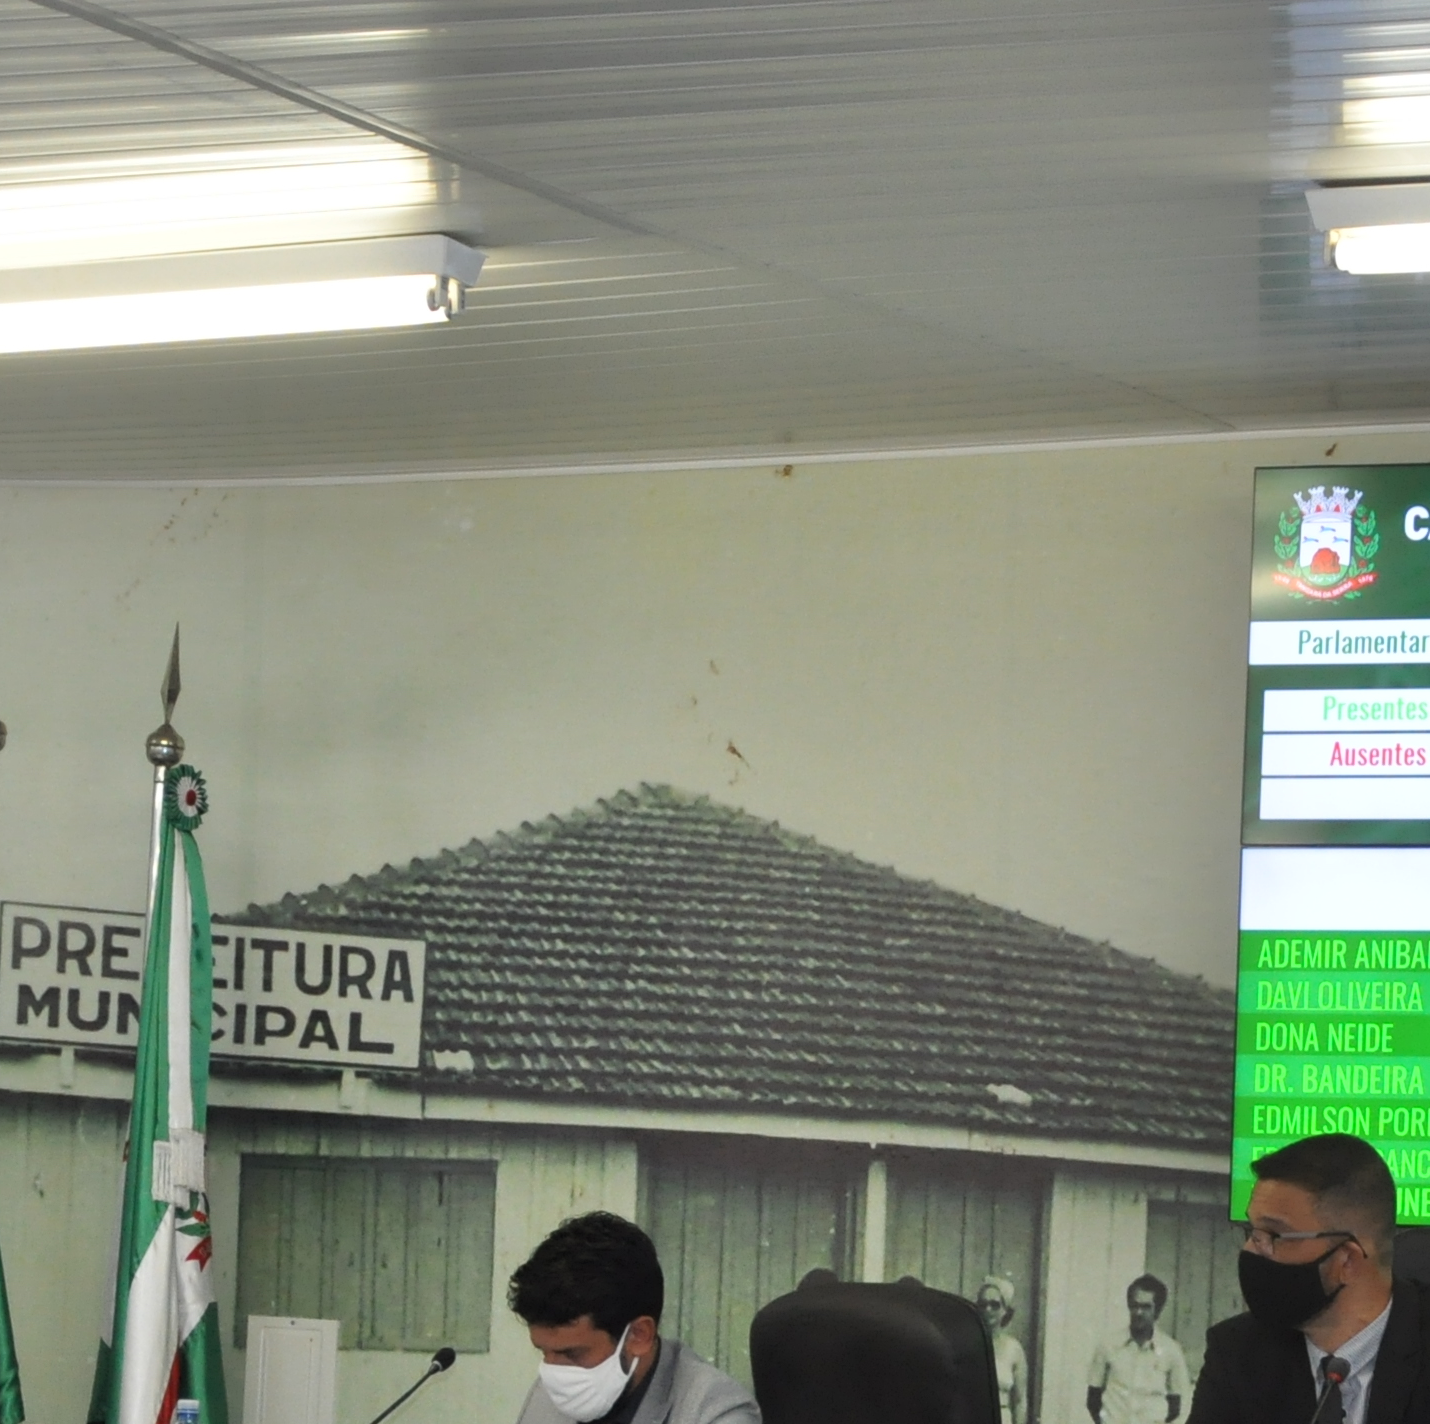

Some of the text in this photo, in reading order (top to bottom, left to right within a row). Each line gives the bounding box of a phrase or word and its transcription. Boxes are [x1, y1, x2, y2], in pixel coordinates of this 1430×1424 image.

[1323, 695, 1428, 723] Presentes
[1329, 740, 1426, 768] Ausentes
[11, 916, 415, 1003] PREITURA
[1258, 939, 1348, 970] ADEMIR
[1256, 981, 1423, 1012] DAVI OLIVEIRA
[16, 983, 396, 1054] MUNIPAL
[1255, 1022, 1393, 1053] DONA NEIDE
[1254, 1064, 1424, 1095] DR. BANDEIRA
[1253, 1105, 1370, 1136] EDMILSON
